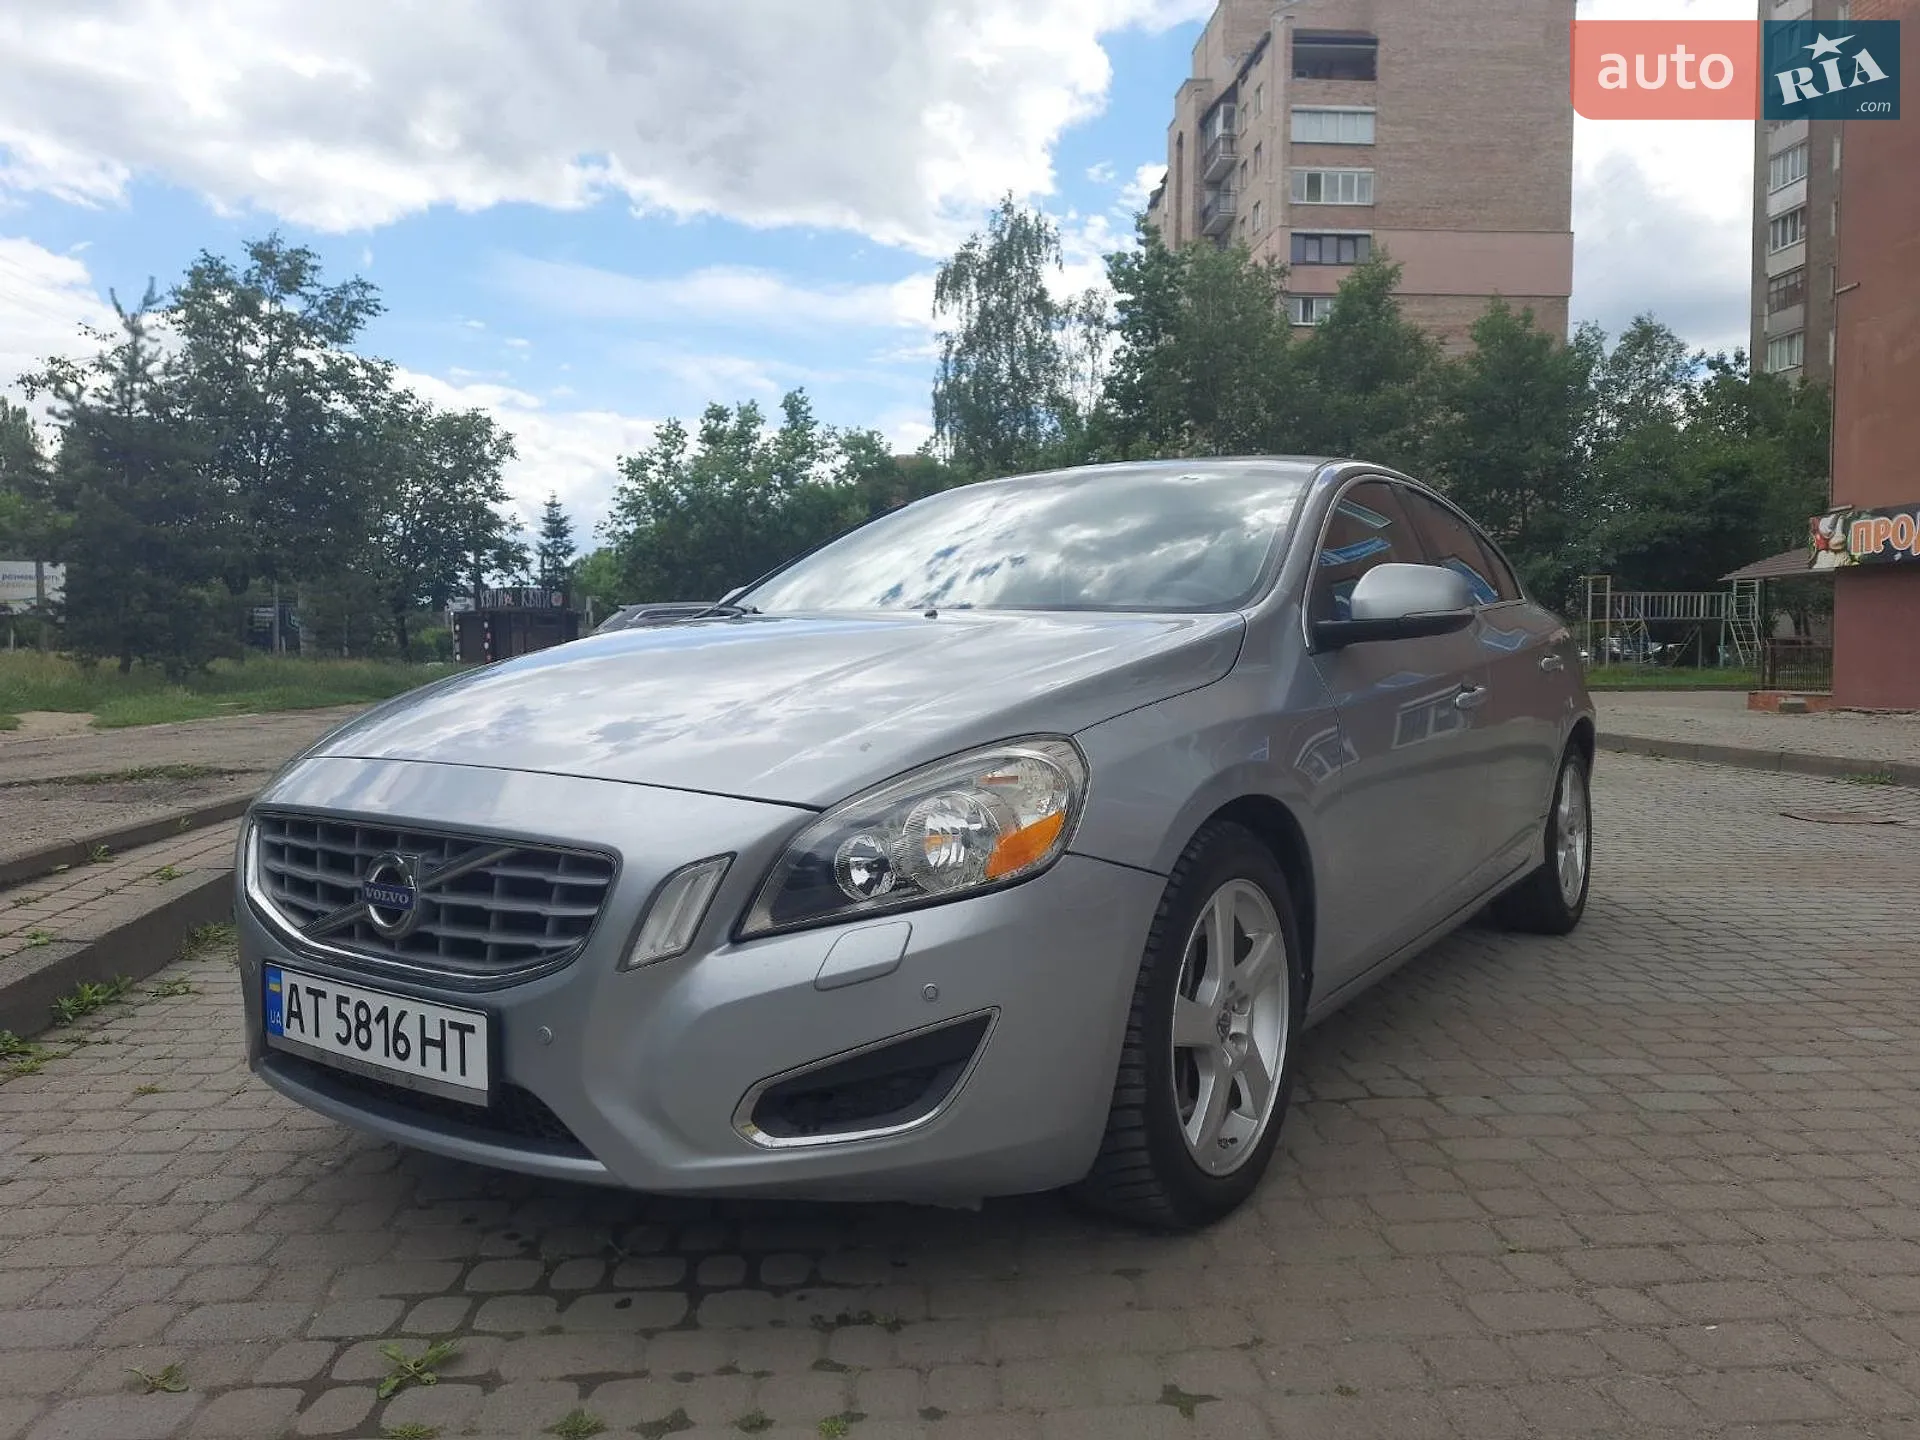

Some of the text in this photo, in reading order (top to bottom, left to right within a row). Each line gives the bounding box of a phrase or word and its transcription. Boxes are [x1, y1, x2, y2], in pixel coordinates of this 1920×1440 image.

[364, 886, 409, 905] VOLVO
[269, 1009, 282, 1027] UA
[285, 983, 327, 1038] AT
[335, 995, 411, 1061] 5816
[419, 1014, 476, 1077] HT
